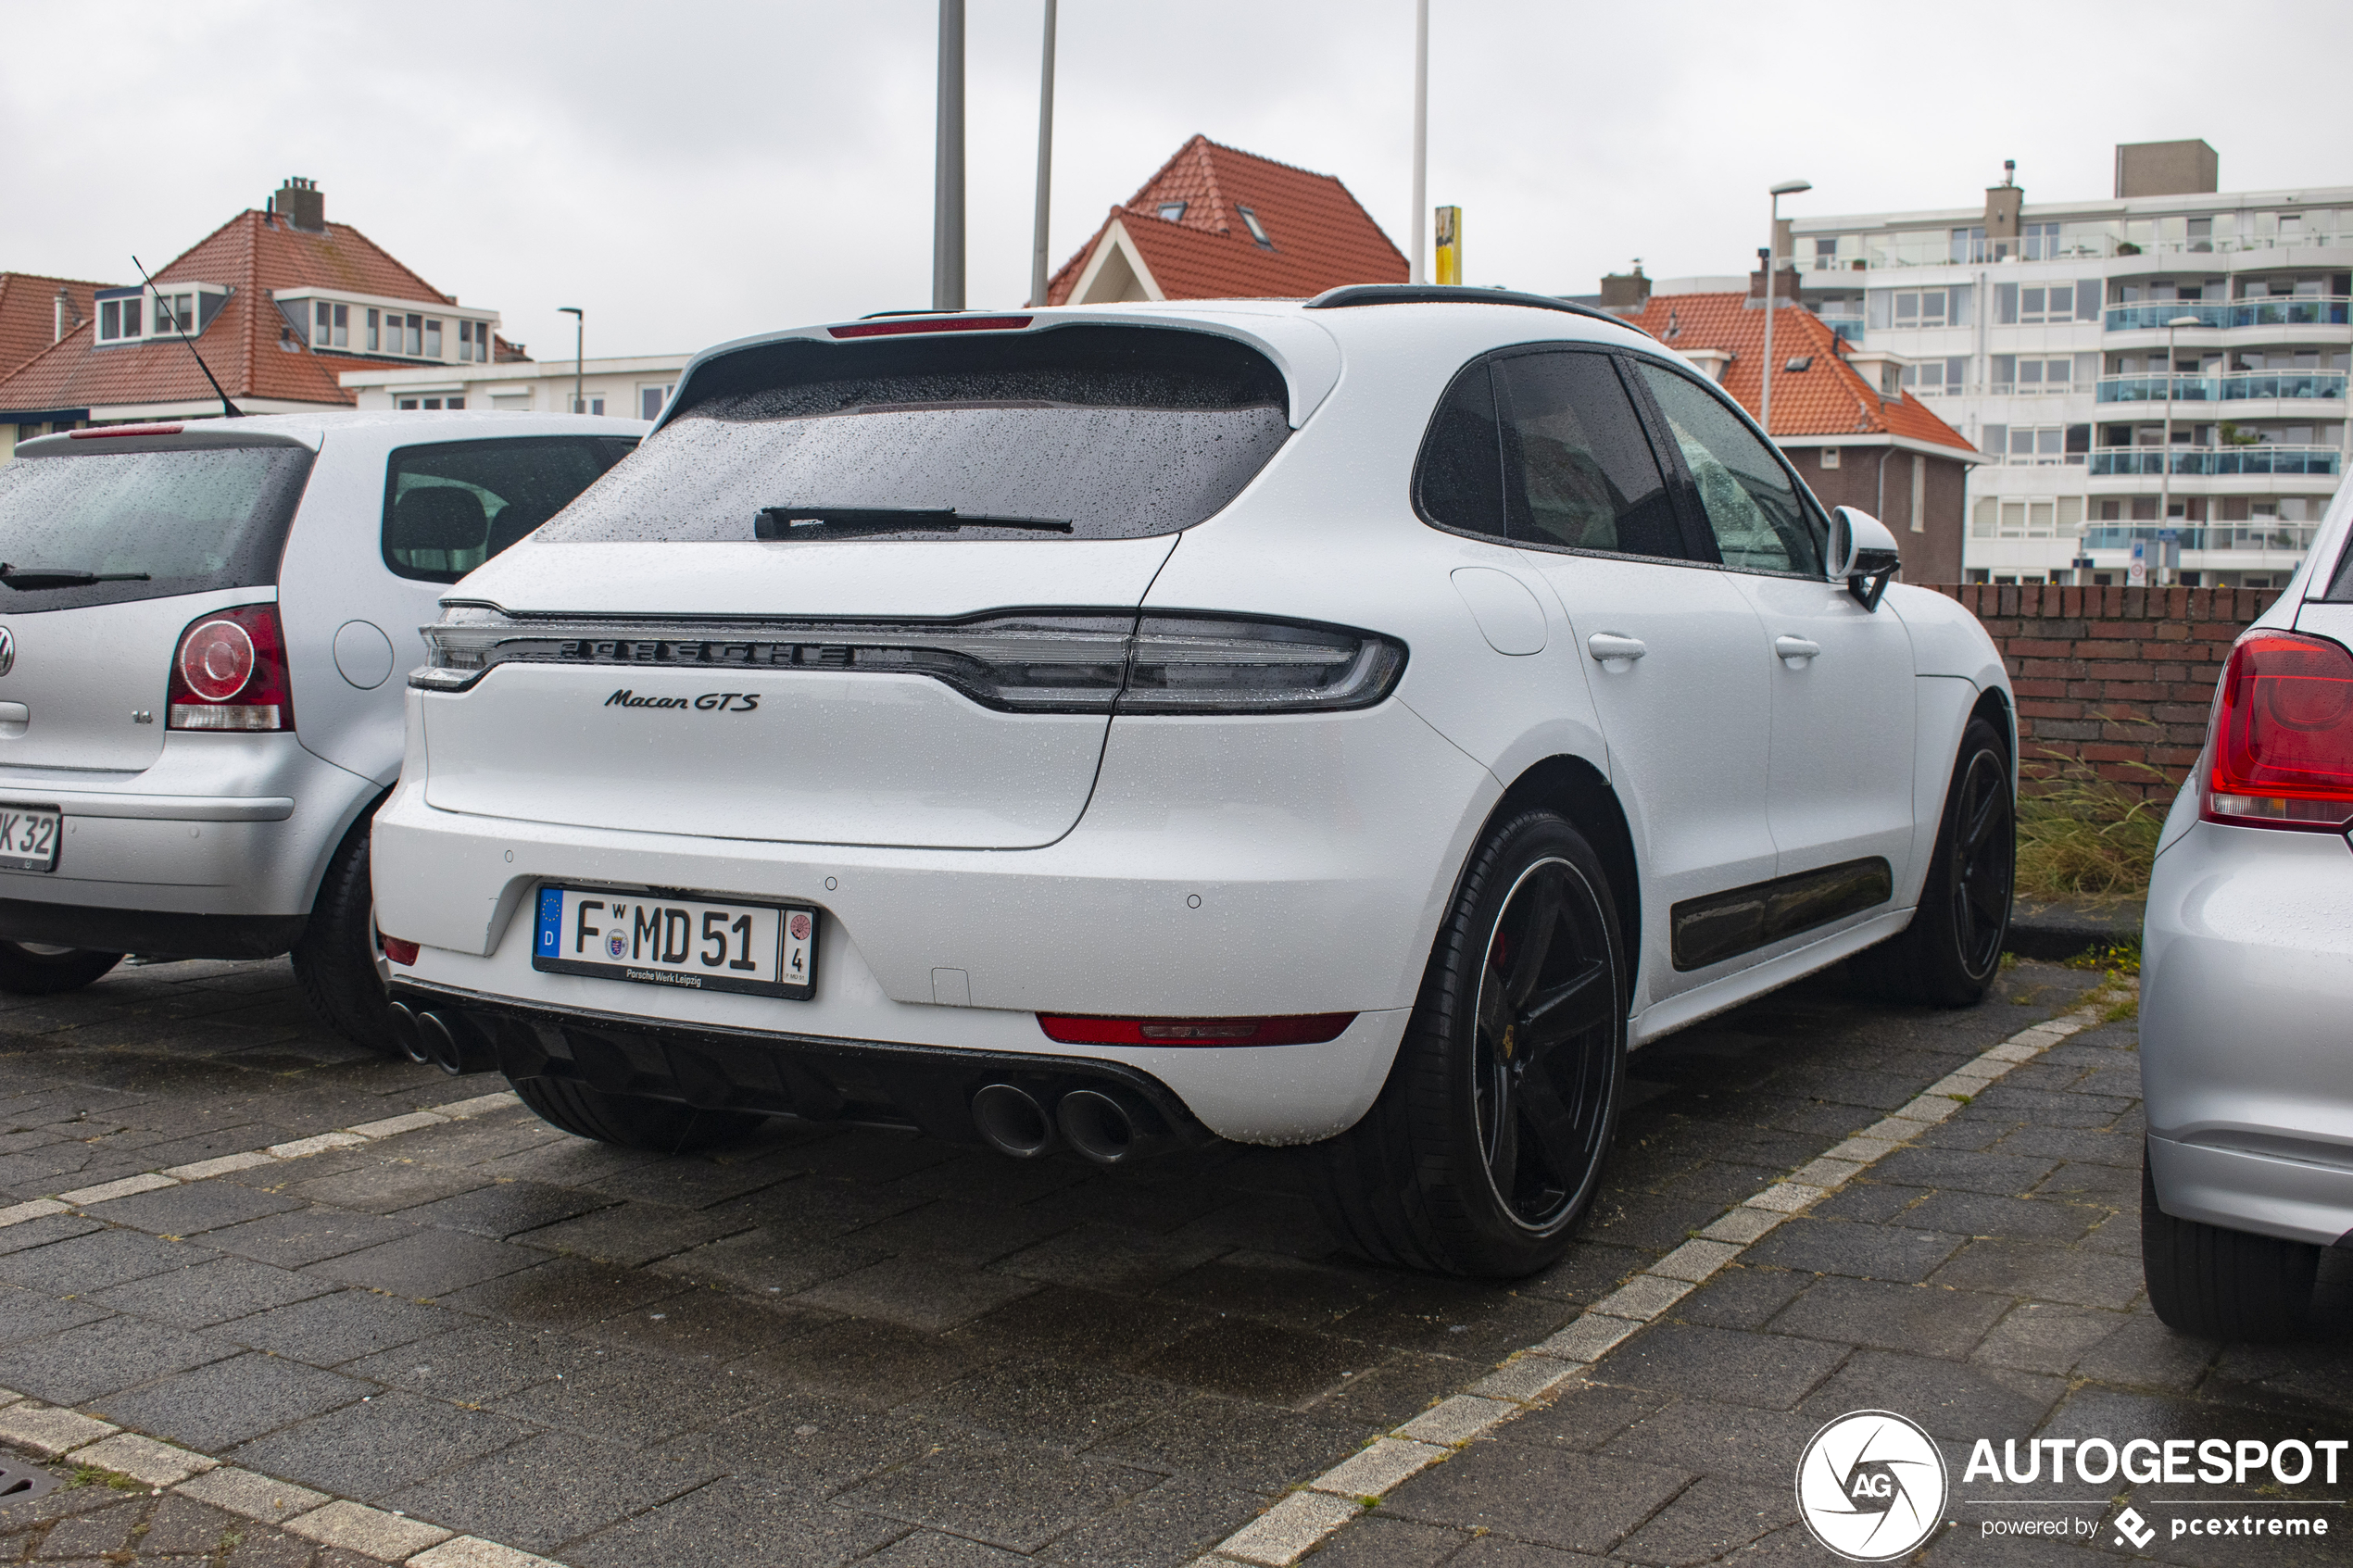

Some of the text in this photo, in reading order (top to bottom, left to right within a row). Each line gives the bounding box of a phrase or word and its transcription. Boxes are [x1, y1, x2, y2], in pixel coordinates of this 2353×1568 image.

[604, 689, 761, 711] Macan GTS
[0, 812, 54, 854] K 32
[545, 930, 554, 946] D
[576, 900, 604, 953] F
[791, 947, 803, 972] 4
[626, 969, 702, 988] Porsche Werk Leipzig
